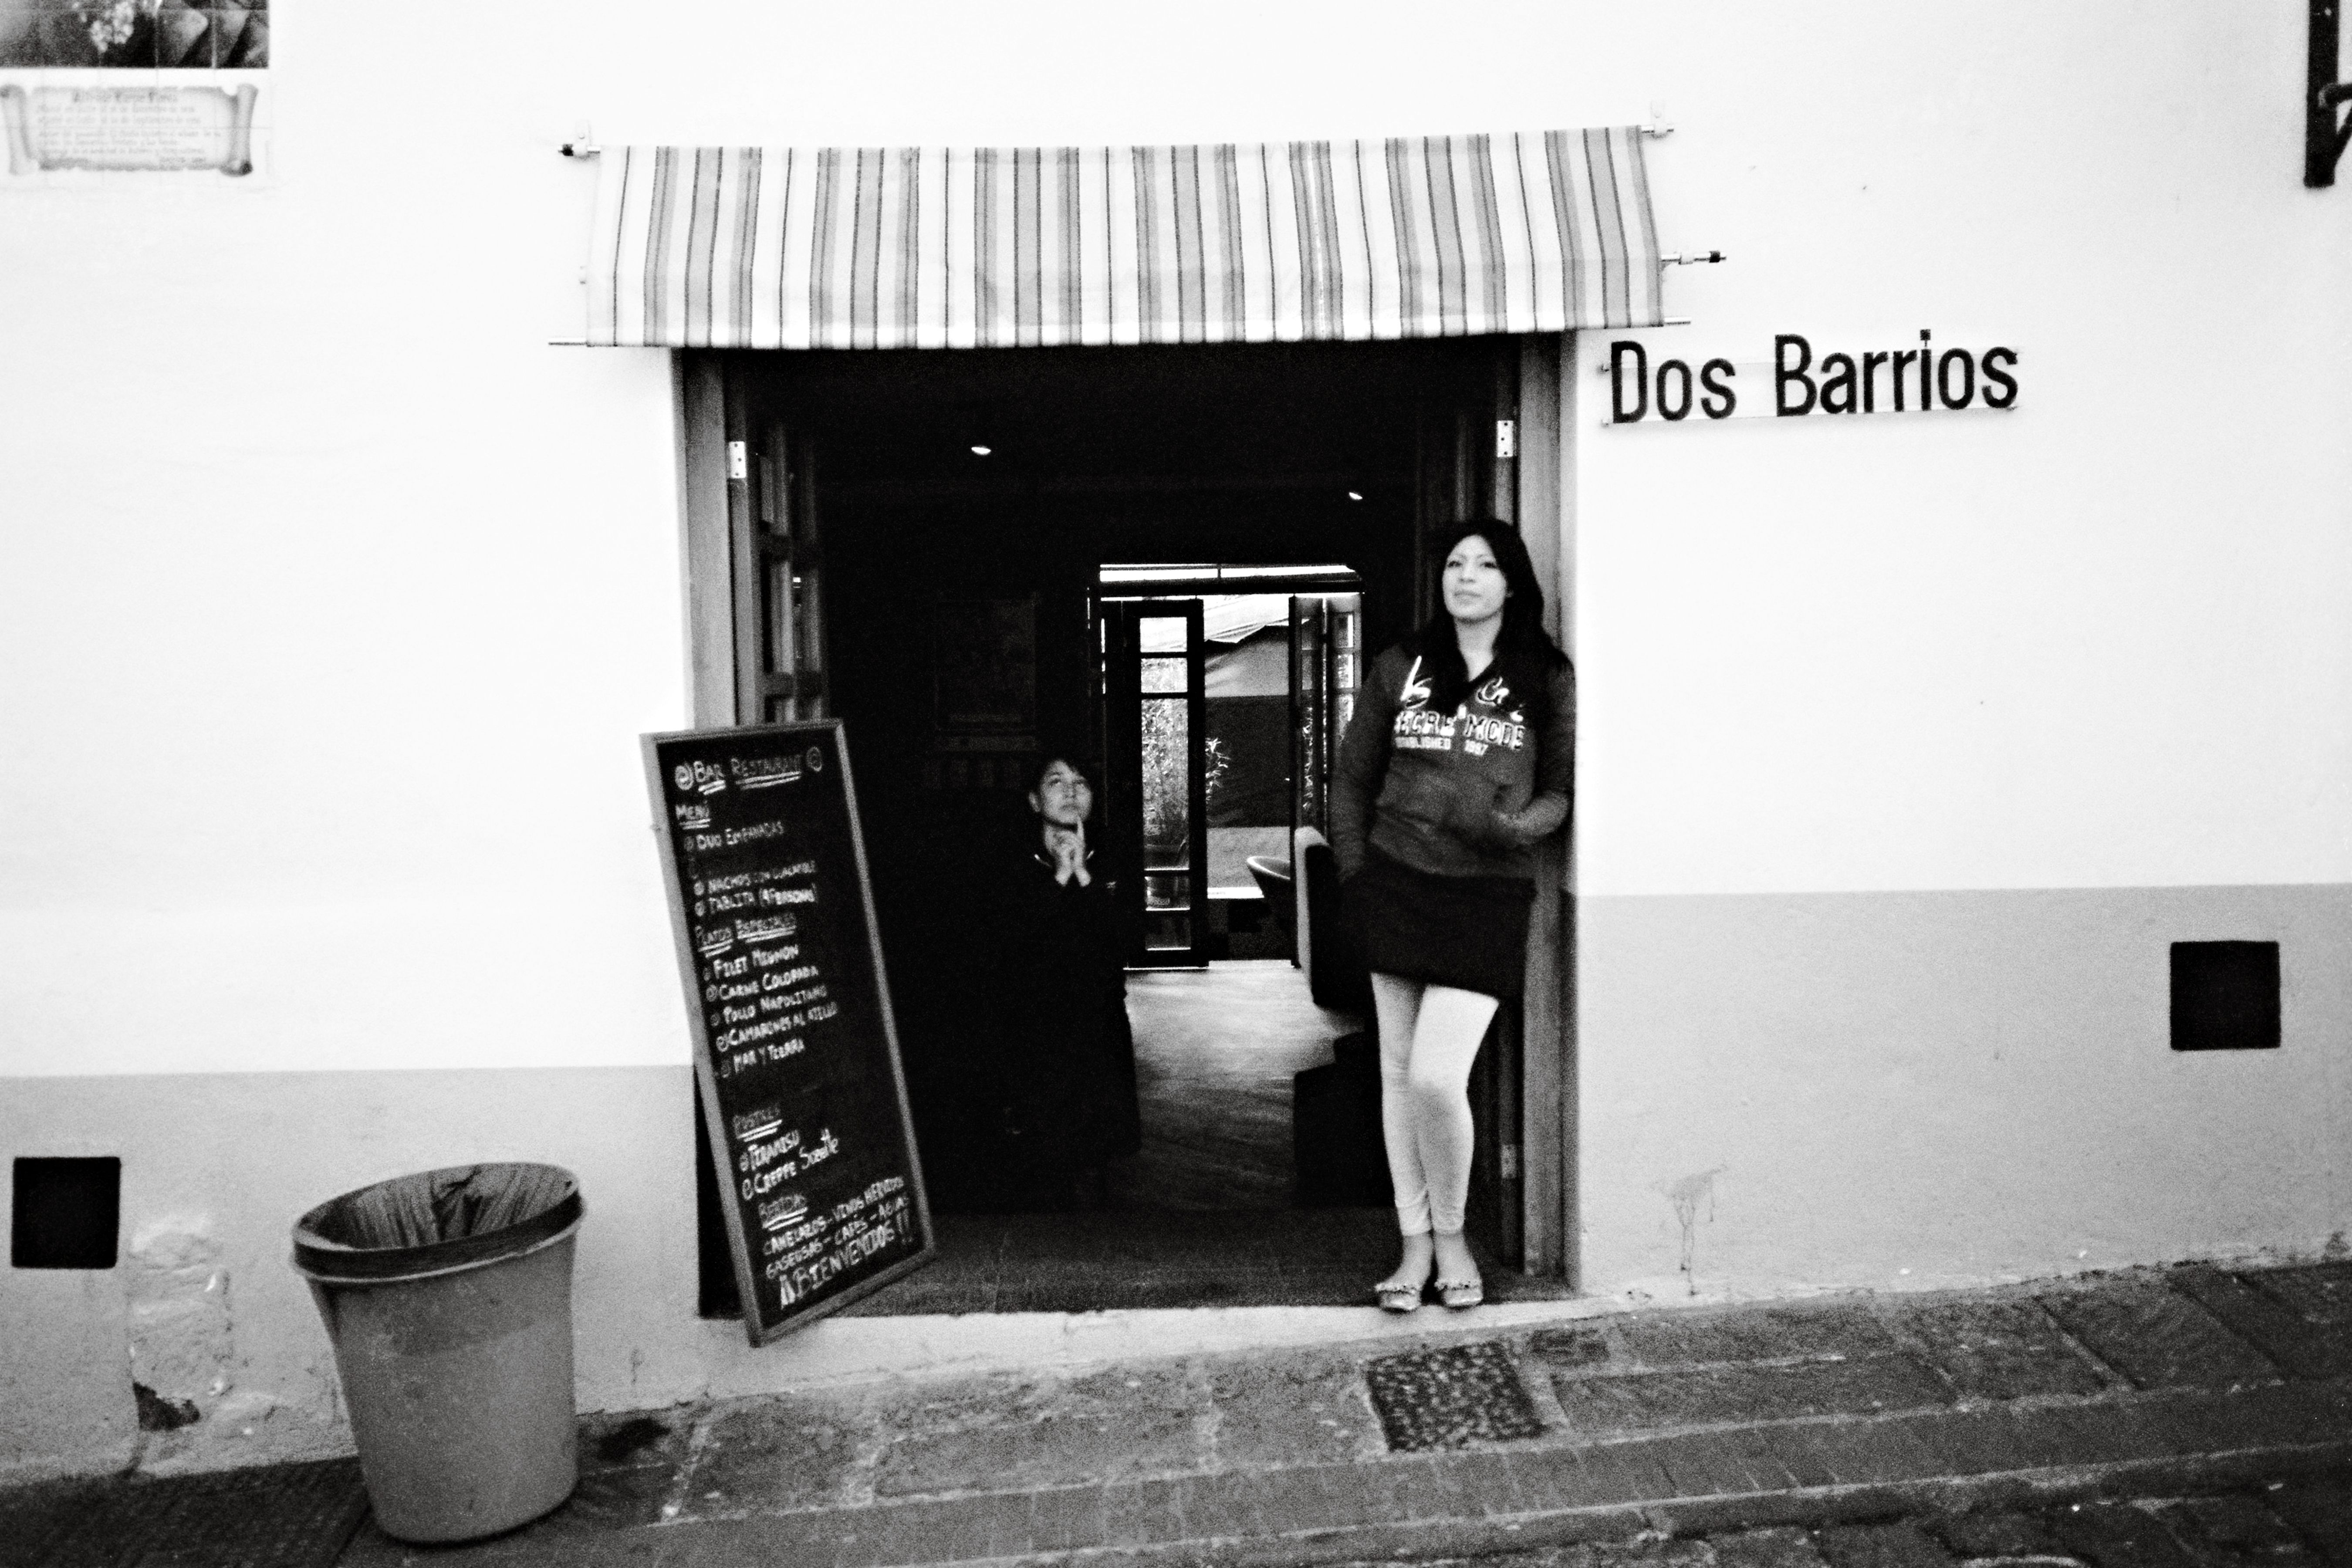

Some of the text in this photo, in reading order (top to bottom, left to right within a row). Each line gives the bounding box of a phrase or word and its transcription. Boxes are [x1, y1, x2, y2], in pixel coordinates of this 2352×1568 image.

[1611, 328, 2018, 423] Dos Barrios
[723, 1004, 757, 1025] POLLO
